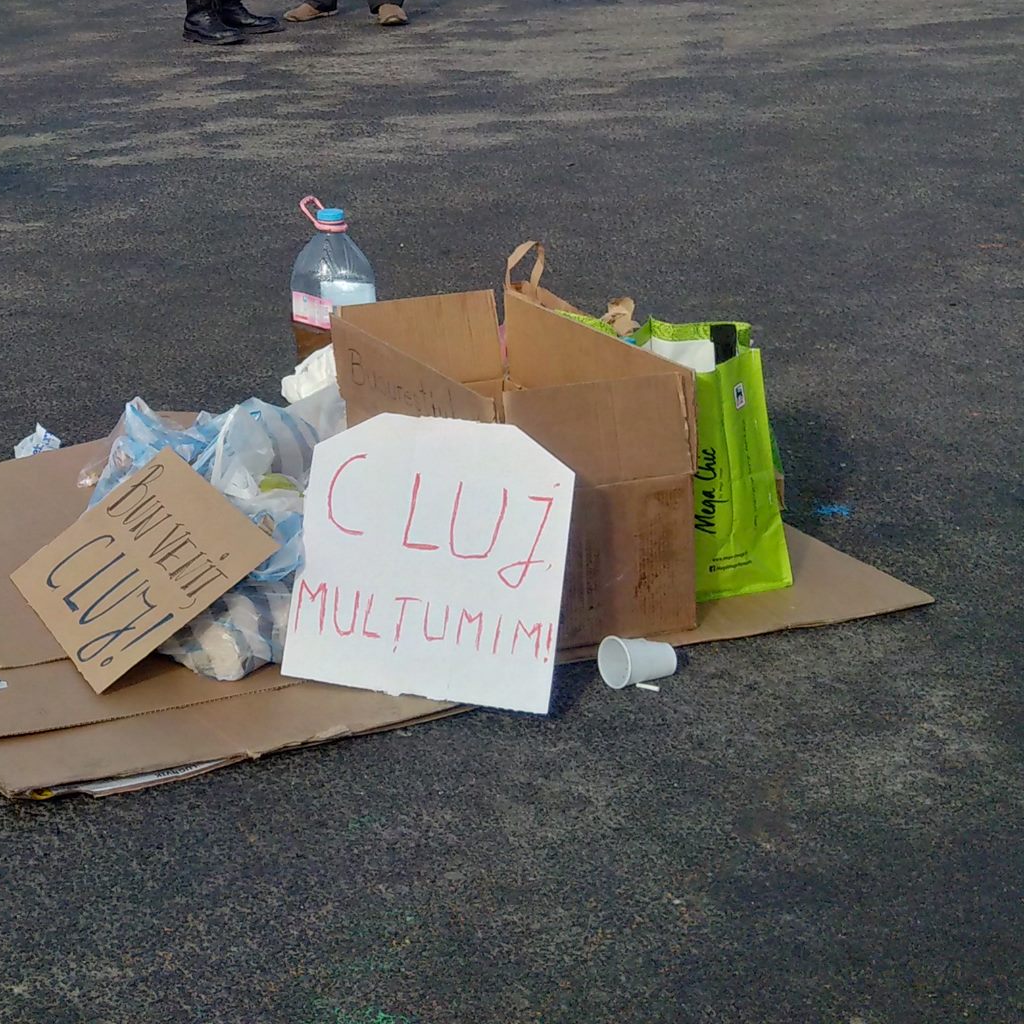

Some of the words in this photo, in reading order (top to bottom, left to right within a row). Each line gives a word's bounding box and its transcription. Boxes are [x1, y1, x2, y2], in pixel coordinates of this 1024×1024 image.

[694, 446, 717, 481] Chic
[106, 464, 173, 541] BUN
[694, 487, 729, 535] Mega
[46, 534, 175, 668] CLUJ!
